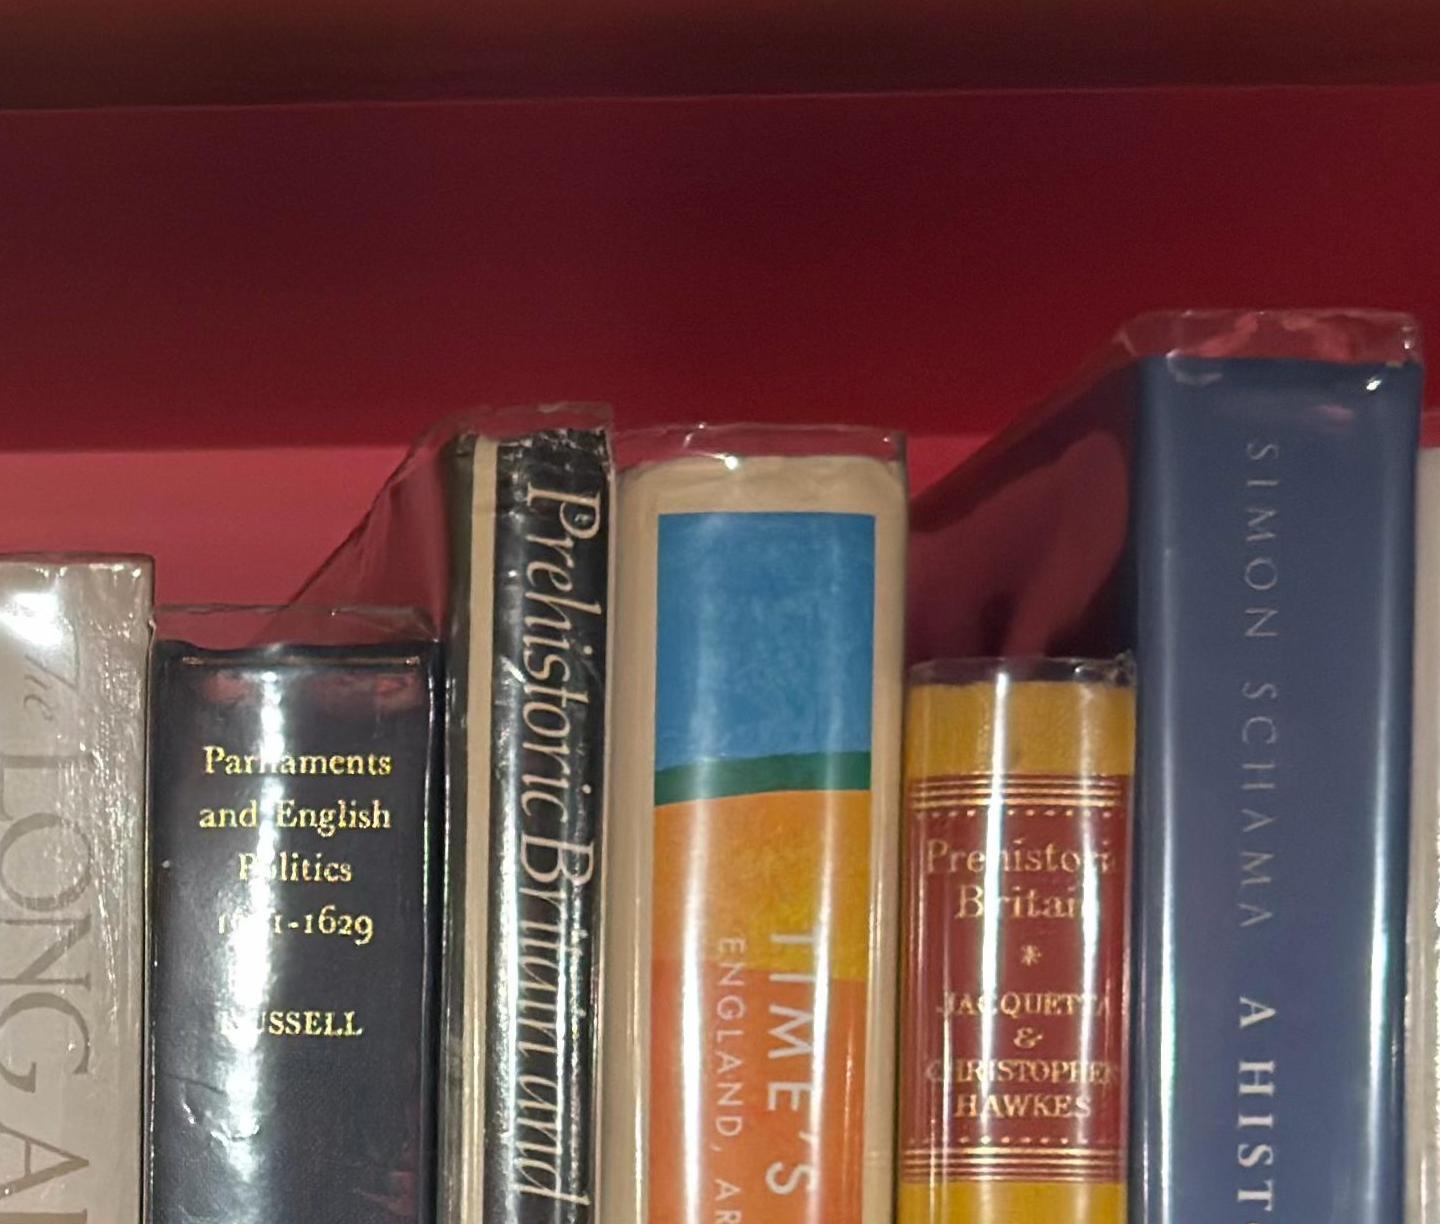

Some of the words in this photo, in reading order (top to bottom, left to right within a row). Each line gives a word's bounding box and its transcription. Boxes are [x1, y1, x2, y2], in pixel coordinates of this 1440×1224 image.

[1243, 441, 1280, 639] SIMON
[520, 481, 604, 825] Prehistoric
[199, 800, 258, 829] and
[276, 799, 392, 838] English
[1238, 680, 1278, 928] SCHAMA
[927, 838, 1116, 874] Preistoi
[954, 884, 1095, 919] Bitai
[218, 904, 374, 946] 11-1629
[517, 834, 595, 1058] Britain
[221, 1010, 365, 1037] SSELL
[1238, 996, 1277, 1030] A
[710, 936, 747, 1153] ENGLAND,
[1013, 1027, 1044, 1049] &
[954, 1094, 1092, 1119] HAWKES
[514, 1074, 592, 1206] and
